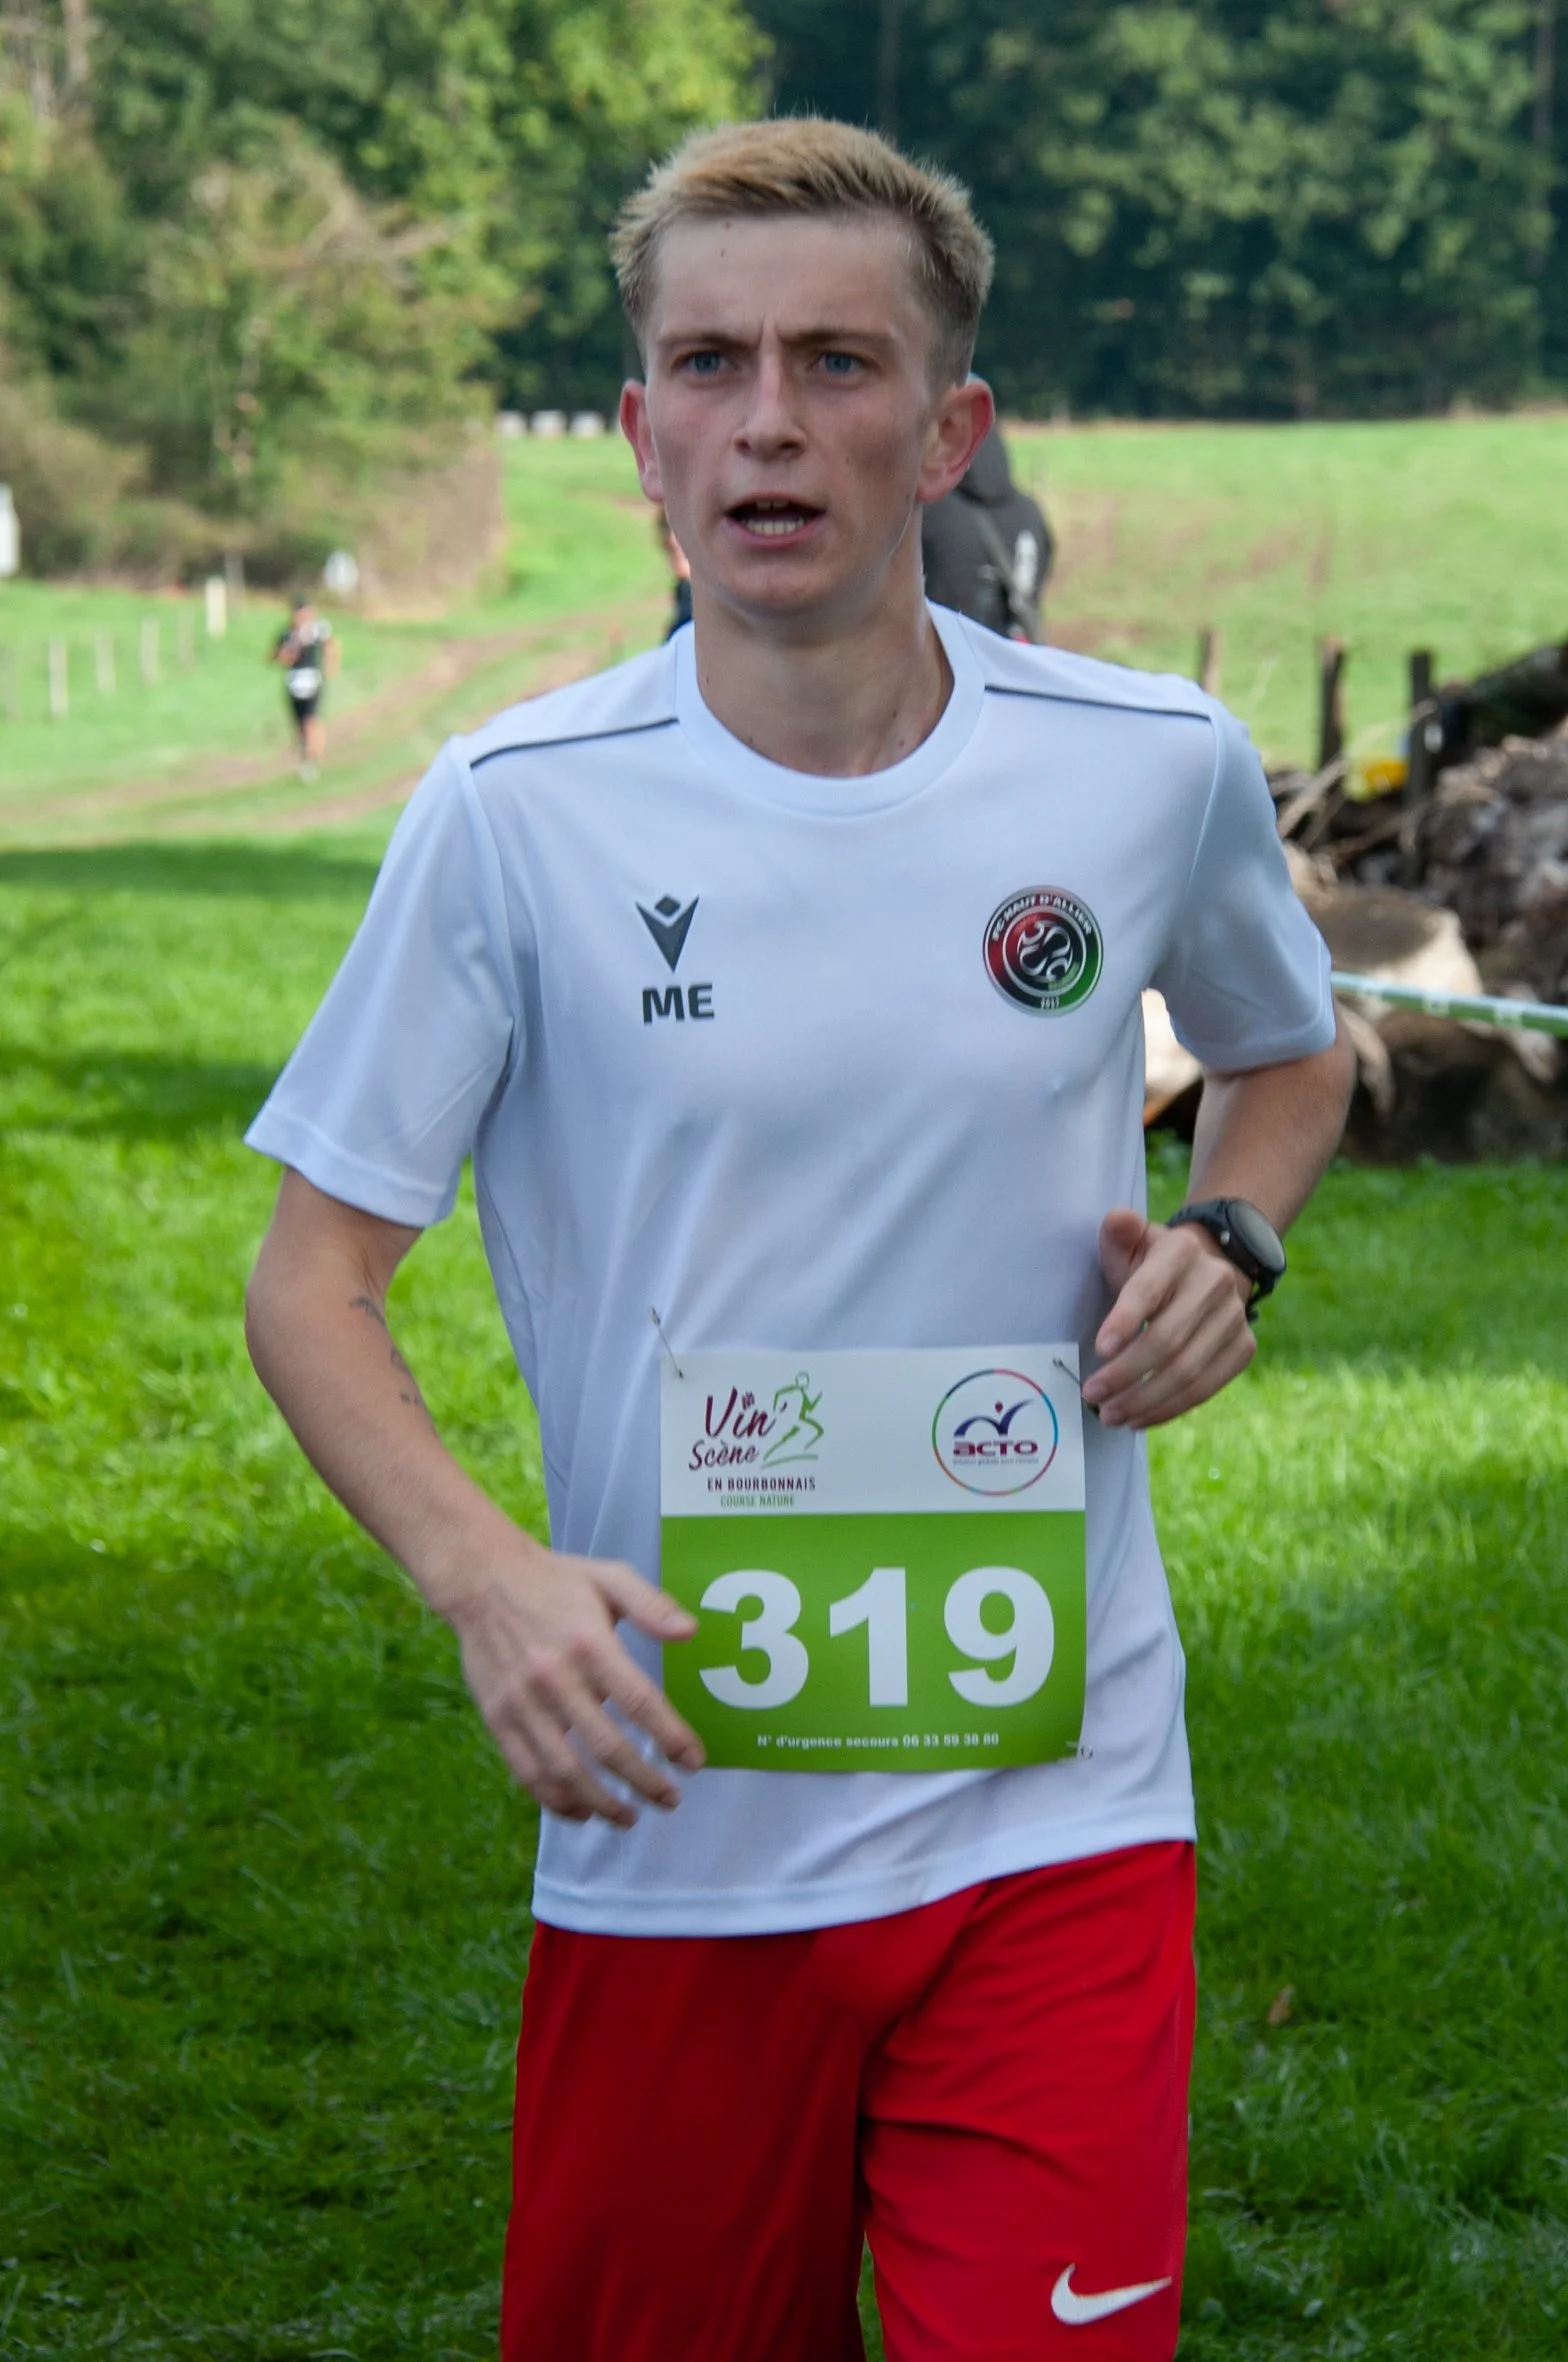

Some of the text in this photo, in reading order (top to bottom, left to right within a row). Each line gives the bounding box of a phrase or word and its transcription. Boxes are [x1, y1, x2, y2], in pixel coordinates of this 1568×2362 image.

[642, 982, 715, 1025] ME
[688, 1439, 760, 1471] Scène
[707, 1476, 816, 1491] EN BOURBONNAIS
[720, 1494, 795, 1507] COURSE NATURE
[699, 1566, 1055, 1710] 319
[776, 1734, 842, 1751] d'urgence
[846, 1736, 899, 1749] secours
[902, 1733, 920, 1748] 06
